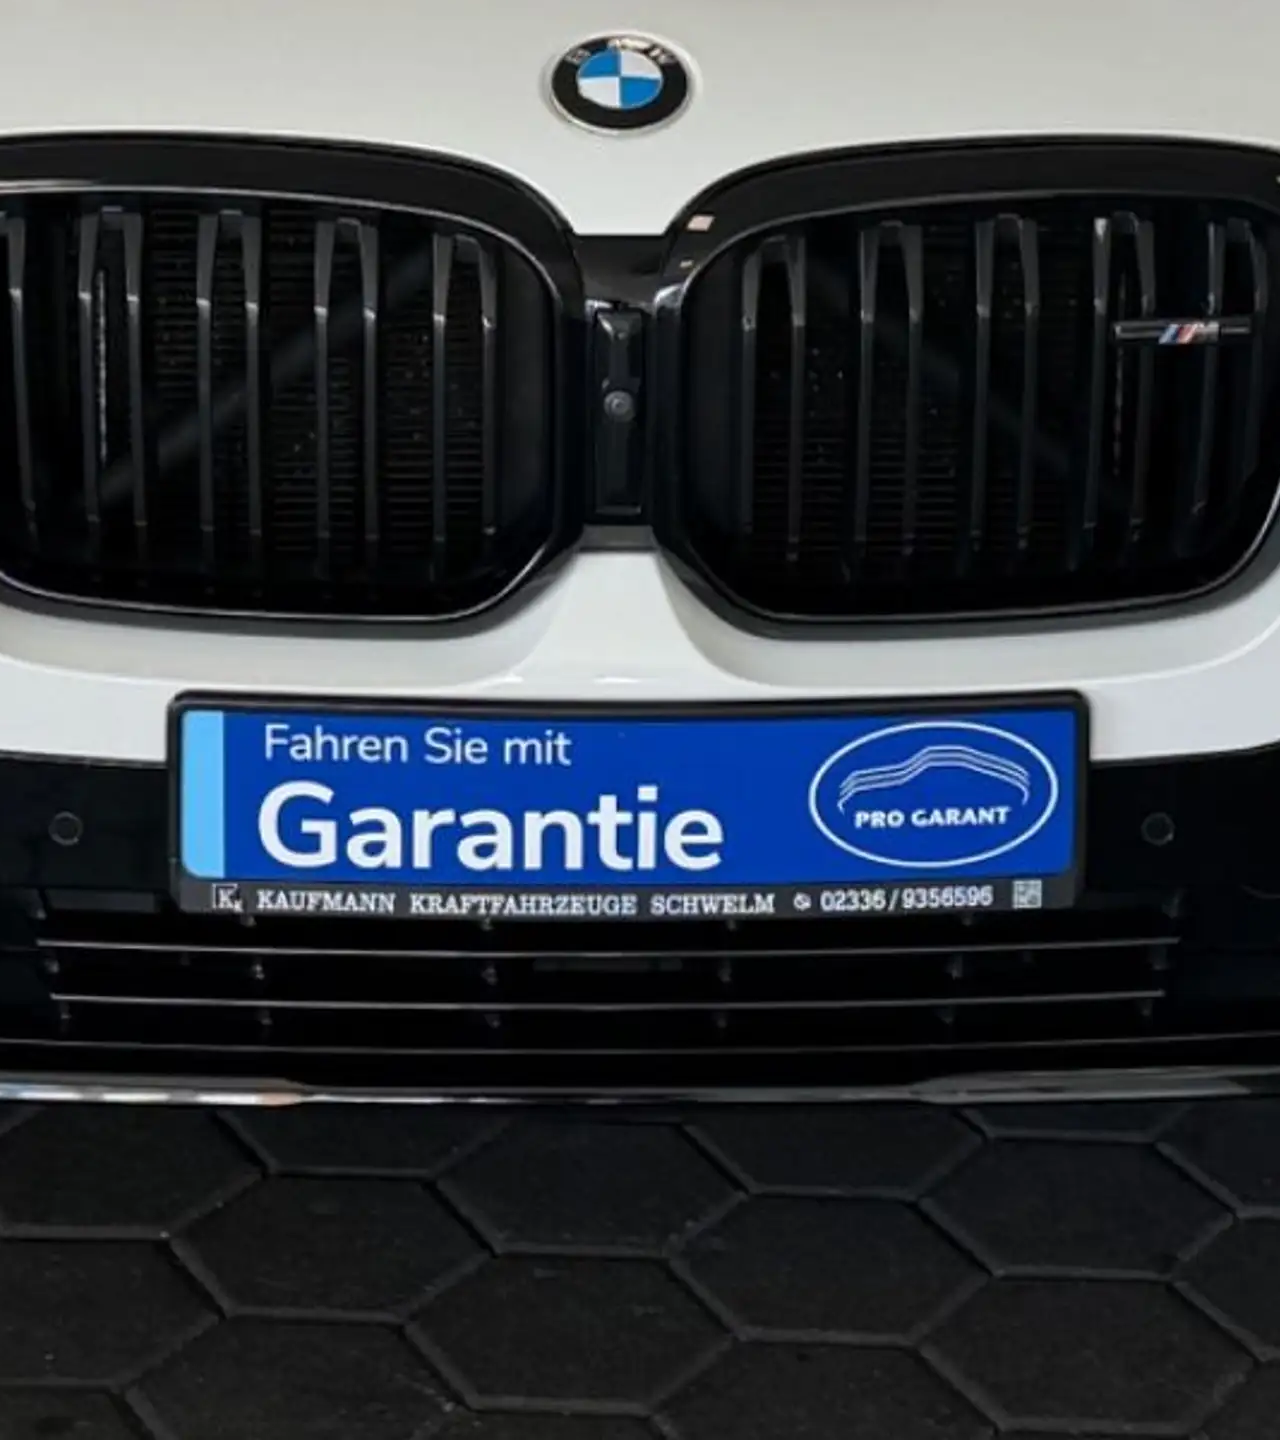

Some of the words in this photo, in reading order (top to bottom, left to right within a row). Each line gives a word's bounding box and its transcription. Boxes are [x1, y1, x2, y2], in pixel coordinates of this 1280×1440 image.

[264, 723, 409, 763] Fahren
[423, 726, 488, 765] Sie
[504, 729, 572, 766] mit
[258, 780, 724, 871] Garantie
[854, 810, 905, 829] PRO
[910, 805, 1012, 828] GARANT
[257, 888, 396, 914] KAUFMANN
[409, 891, 638, 916] KRAFTFAHRZEUGE
[650, 892, 776, 916] SCHWELM
